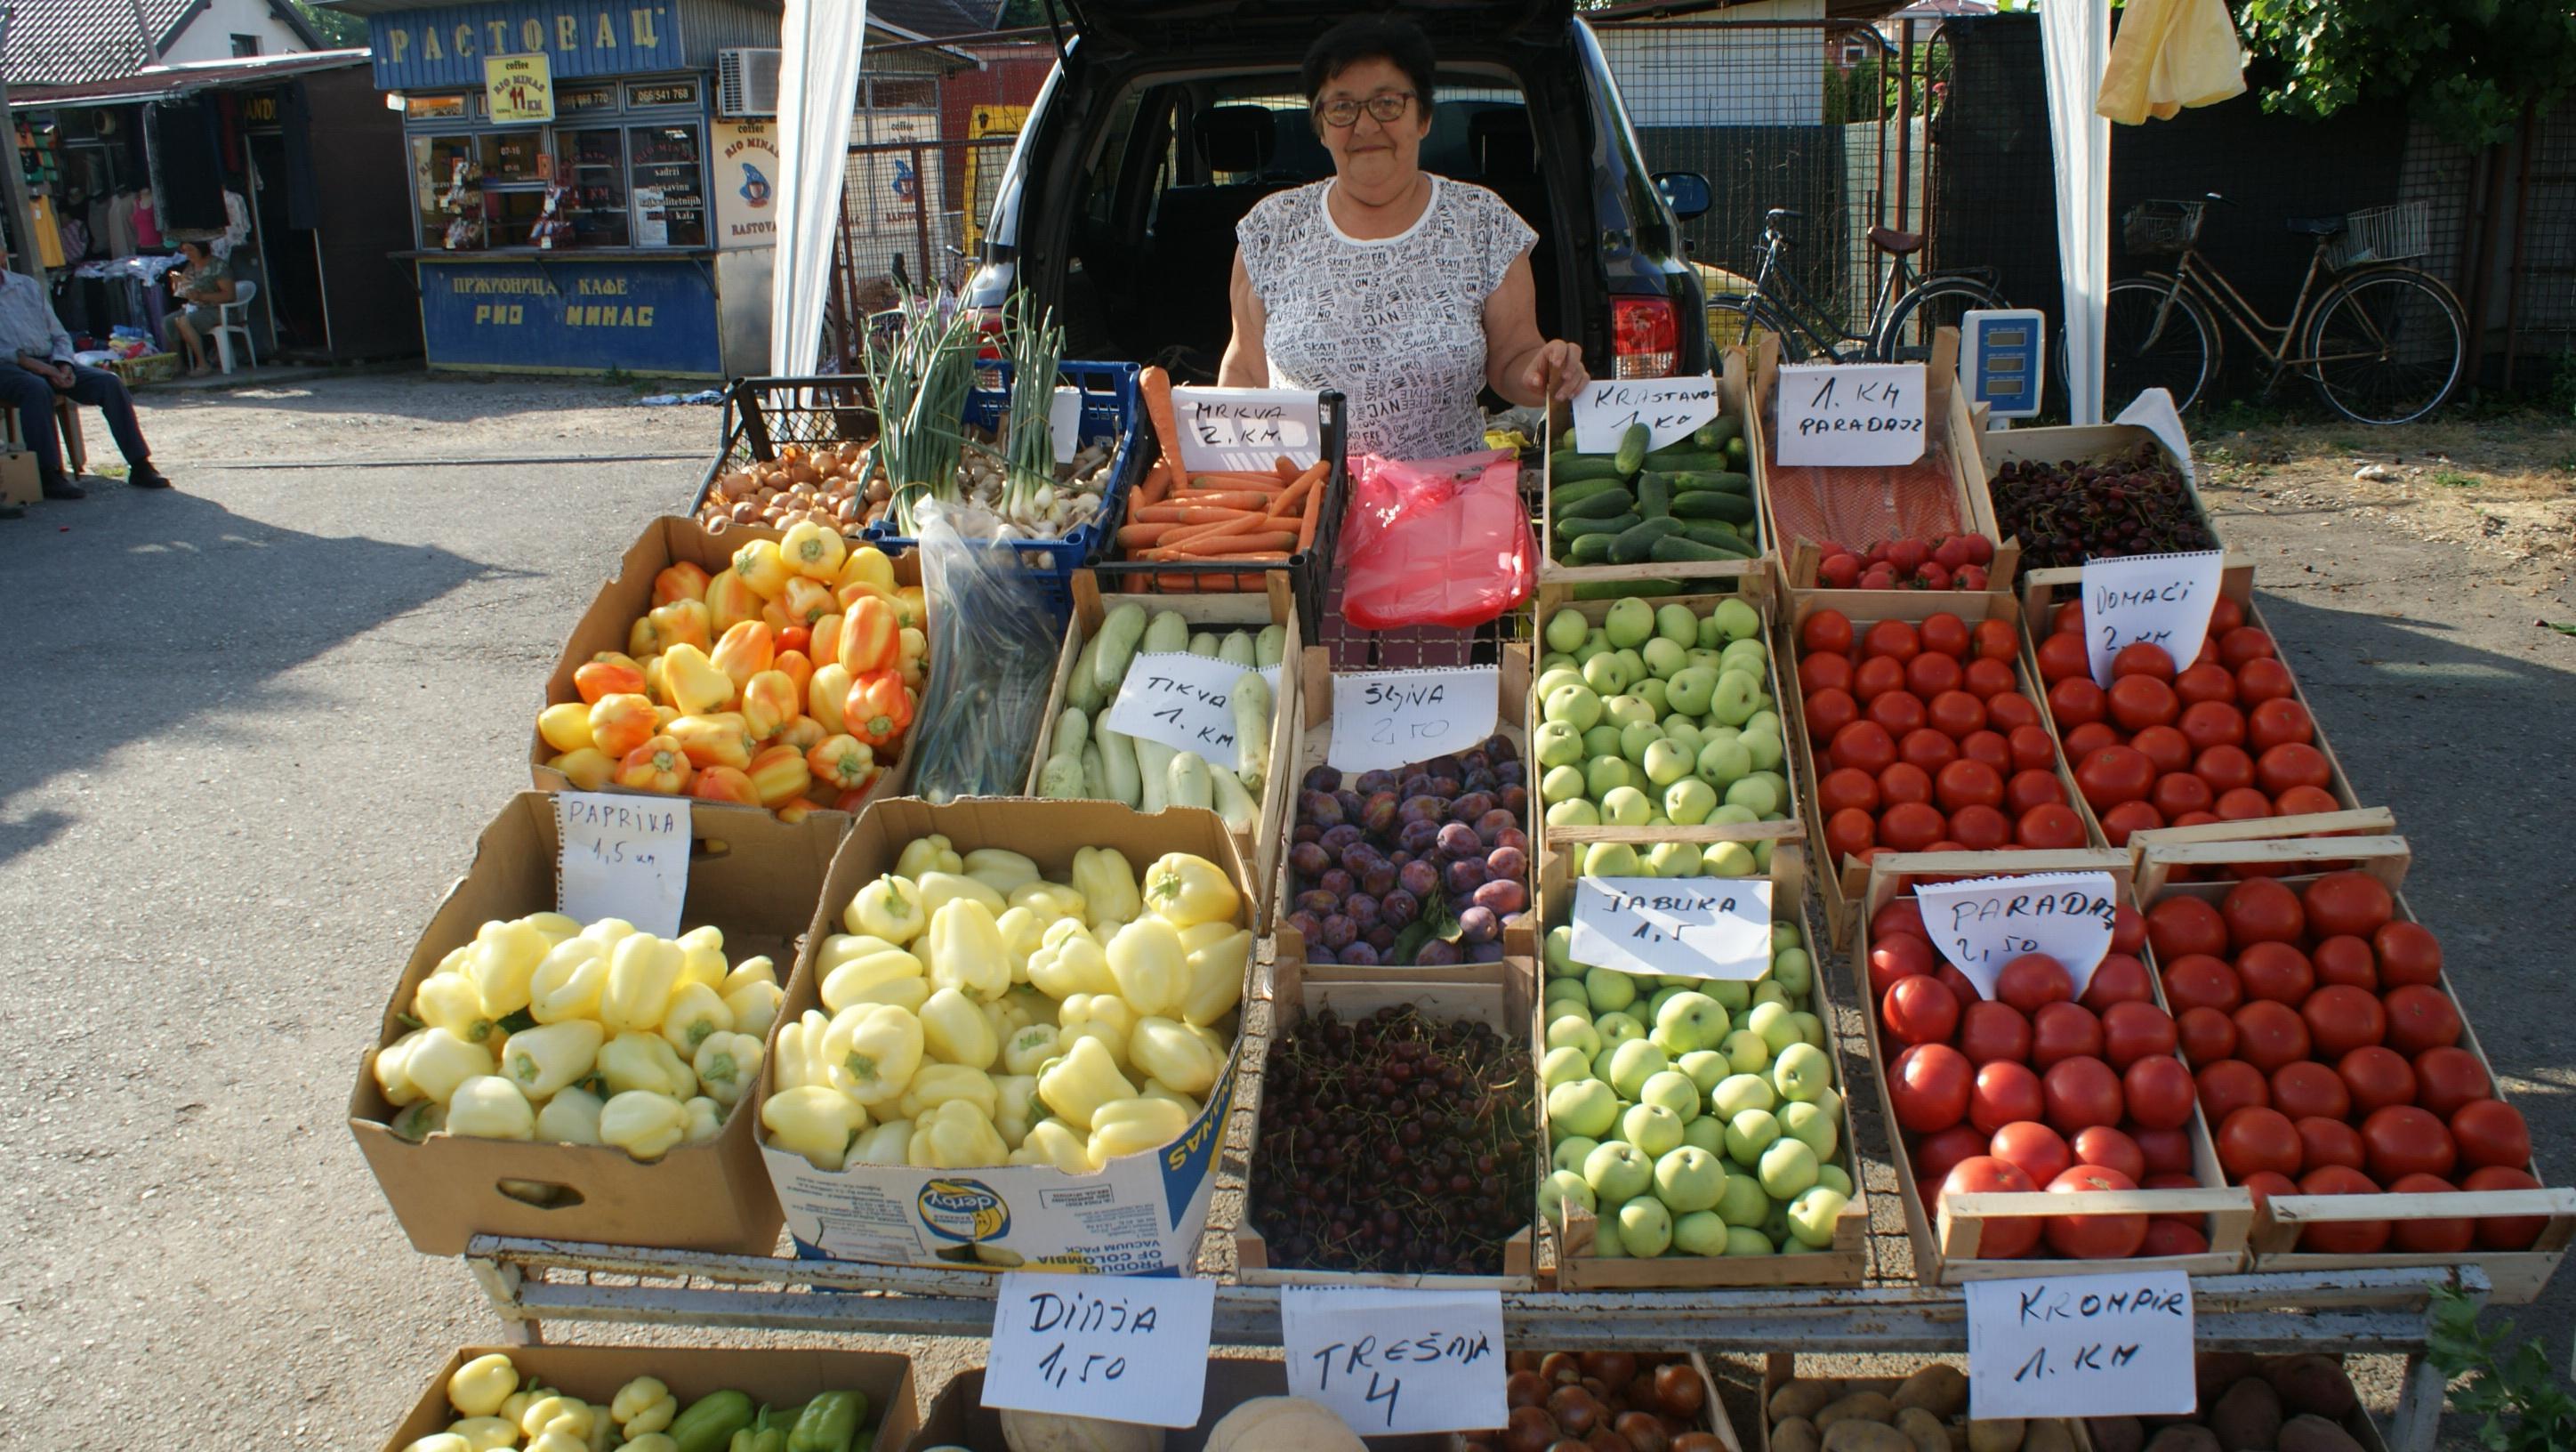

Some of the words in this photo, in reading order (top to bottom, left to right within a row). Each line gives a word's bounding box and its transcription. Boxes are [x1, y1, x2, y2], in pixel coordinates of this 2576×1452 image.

[505, 60, 529, 70] coffee
[512, 75, 545, 93] MINAS
[509, 85, 526, 110] 11
[527, 100, 543, 111] KM
[737, 124, 764, 133] coffee
[890, 120, 914, 132] coffee
[725, 140, 744, 158] RIO
[1467, 193, 1480, 202] ON
[731, 221, 777, 236] RASTOVA
[578, 278, 627, 295] КАФЕ
[1355, 278, 1368, 288] ON
[1466, 282, 1477, 292] ON
[475, 305, 523, 325] РИО
[566, 305, 655, 327] МИНАС
[1317, 310, 1332, 319] NO
[1349, 362, 1366, 373] ON
[1400, 360, 1422, 372] BRO
[1196, 401, 1287, 421] MRKVA
[1366, 399, 1401, 418] NYC
[1463, 446, 1473, 455] ON
[1147, 676, 1227, 708] TIKVA
[1197, 726, 1234, 748] KM
[593, 837, 627, 864] 1,5
[1602, 891, 1736, 913] JABUKA
[930, 1191, 992, 1212] derby
[1104, 1239, 1161, 1252] VACUUM
[1036, 1252, 1132, 1265] COLOMBIA
[1139, 1249, 1163, 1260] OF
[1078, 1260, 1164, 1274] PRODUCE
[2074, 1343, 2142, 1370] KM
[1039, 1343, 1125, 1389] 1,50
[1365, 1371, 1400, 1427] 4
